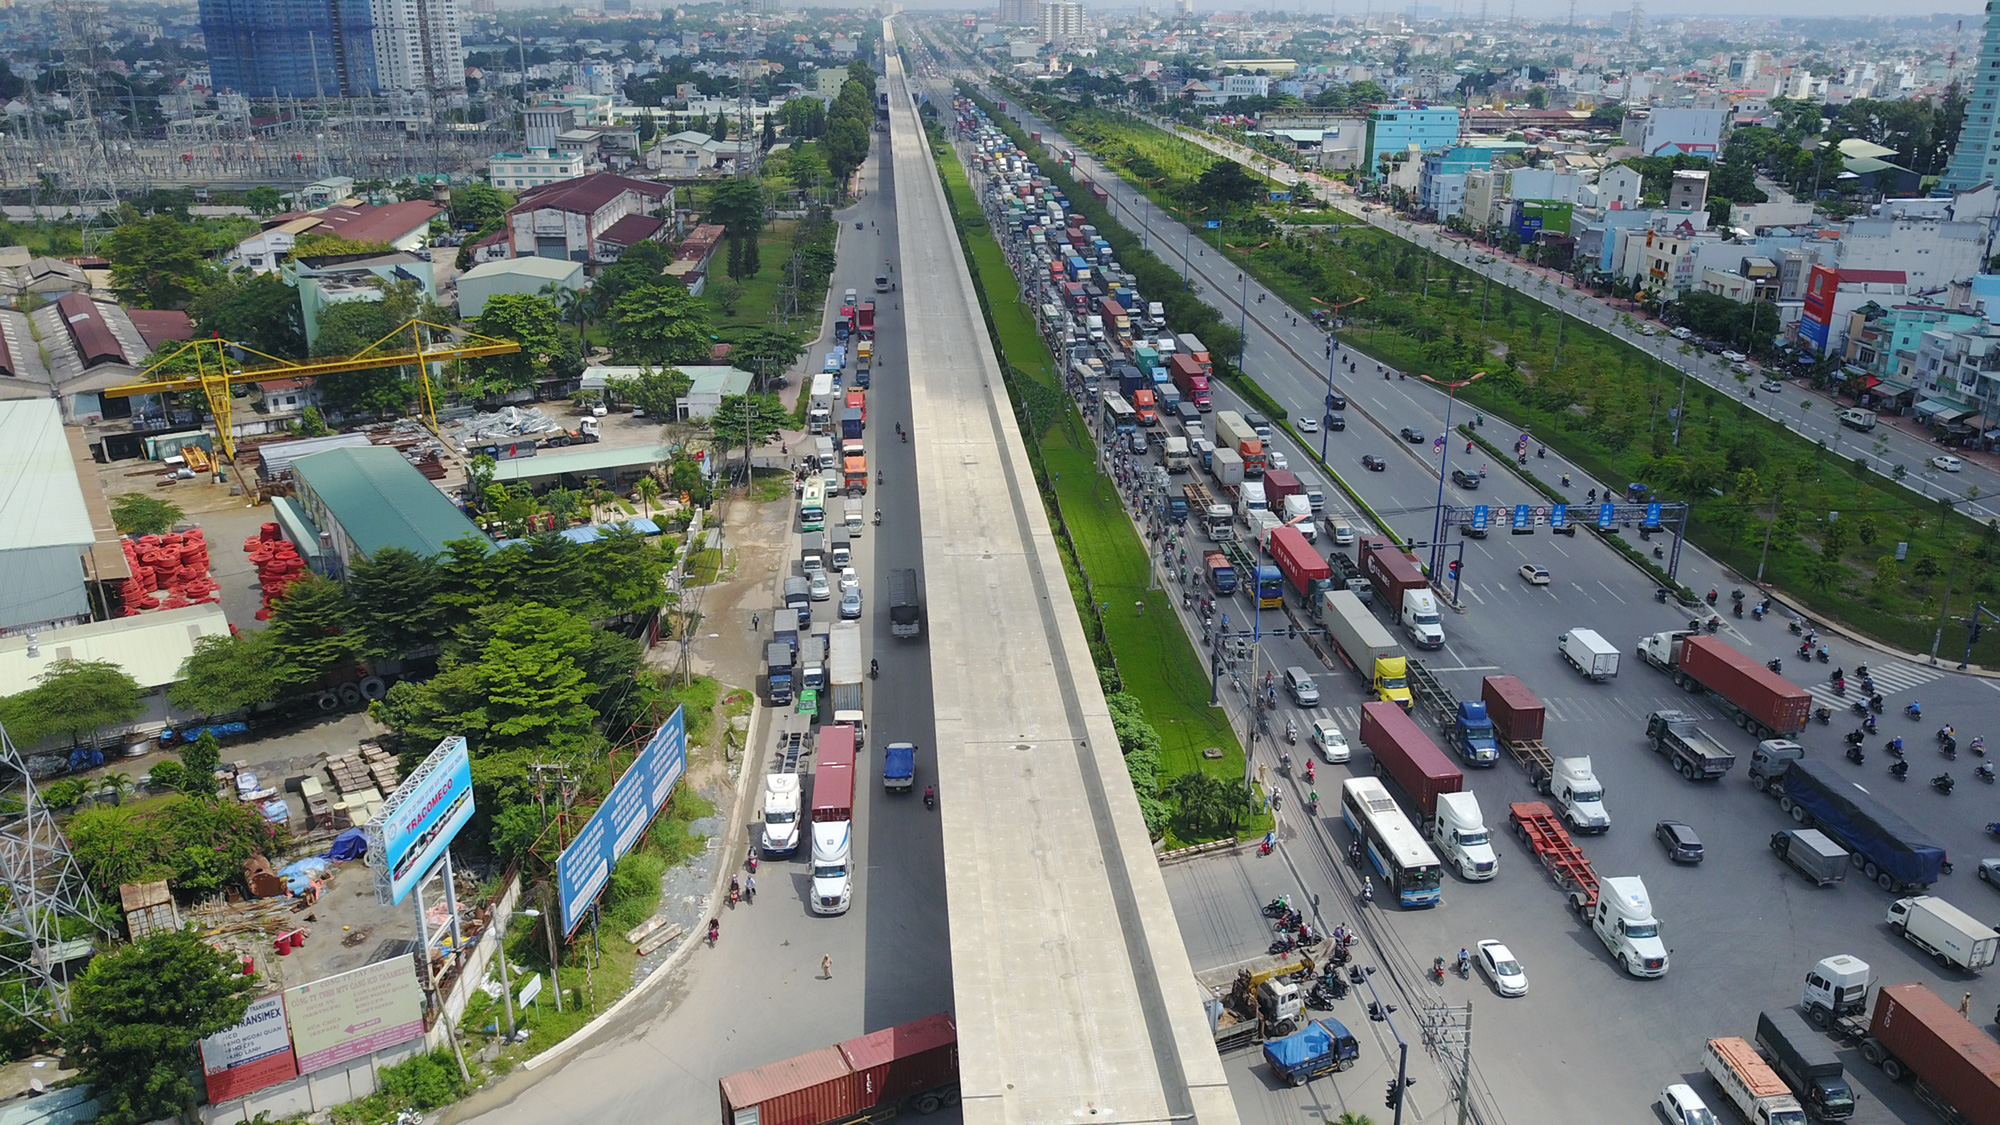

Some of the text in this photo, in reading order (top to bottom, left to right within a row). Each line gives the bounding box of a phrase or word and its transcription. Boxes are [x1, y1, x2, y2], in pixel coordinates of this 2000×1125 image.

[406, 779, 453, 835] TRACOMECO
[250, 1000, 276, 1012] TRANSIMEX
[264, 1026, 282, 1036] QUAN
[228, 1045, 242, 1053] KHO
